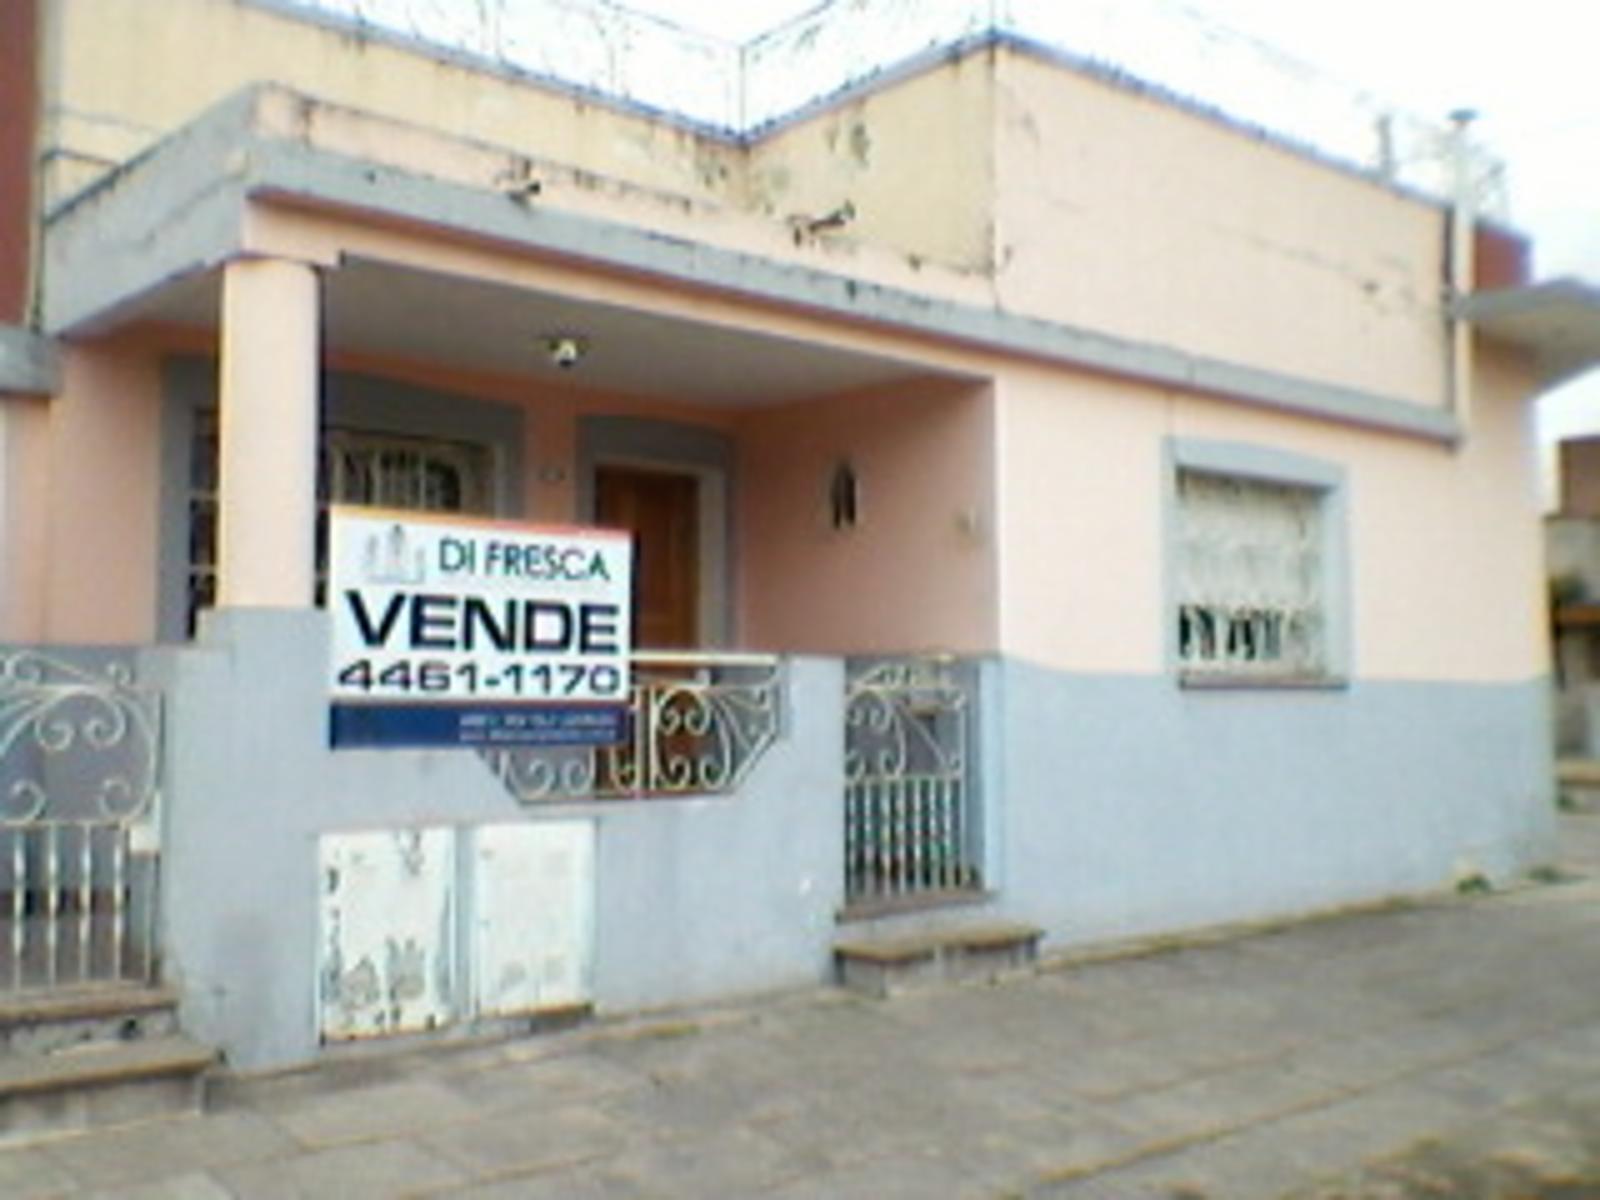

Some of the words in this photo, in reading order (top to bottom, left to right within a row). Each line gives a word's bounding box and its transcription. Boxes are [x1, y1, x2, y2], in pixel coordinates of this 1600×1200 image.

[439, 537, 475, 574] DI
[485, 539, 611, 581] FRESCA
[345, 588, 620, 655] VENDE
[338, 659, 621, 695] 4461-1170
